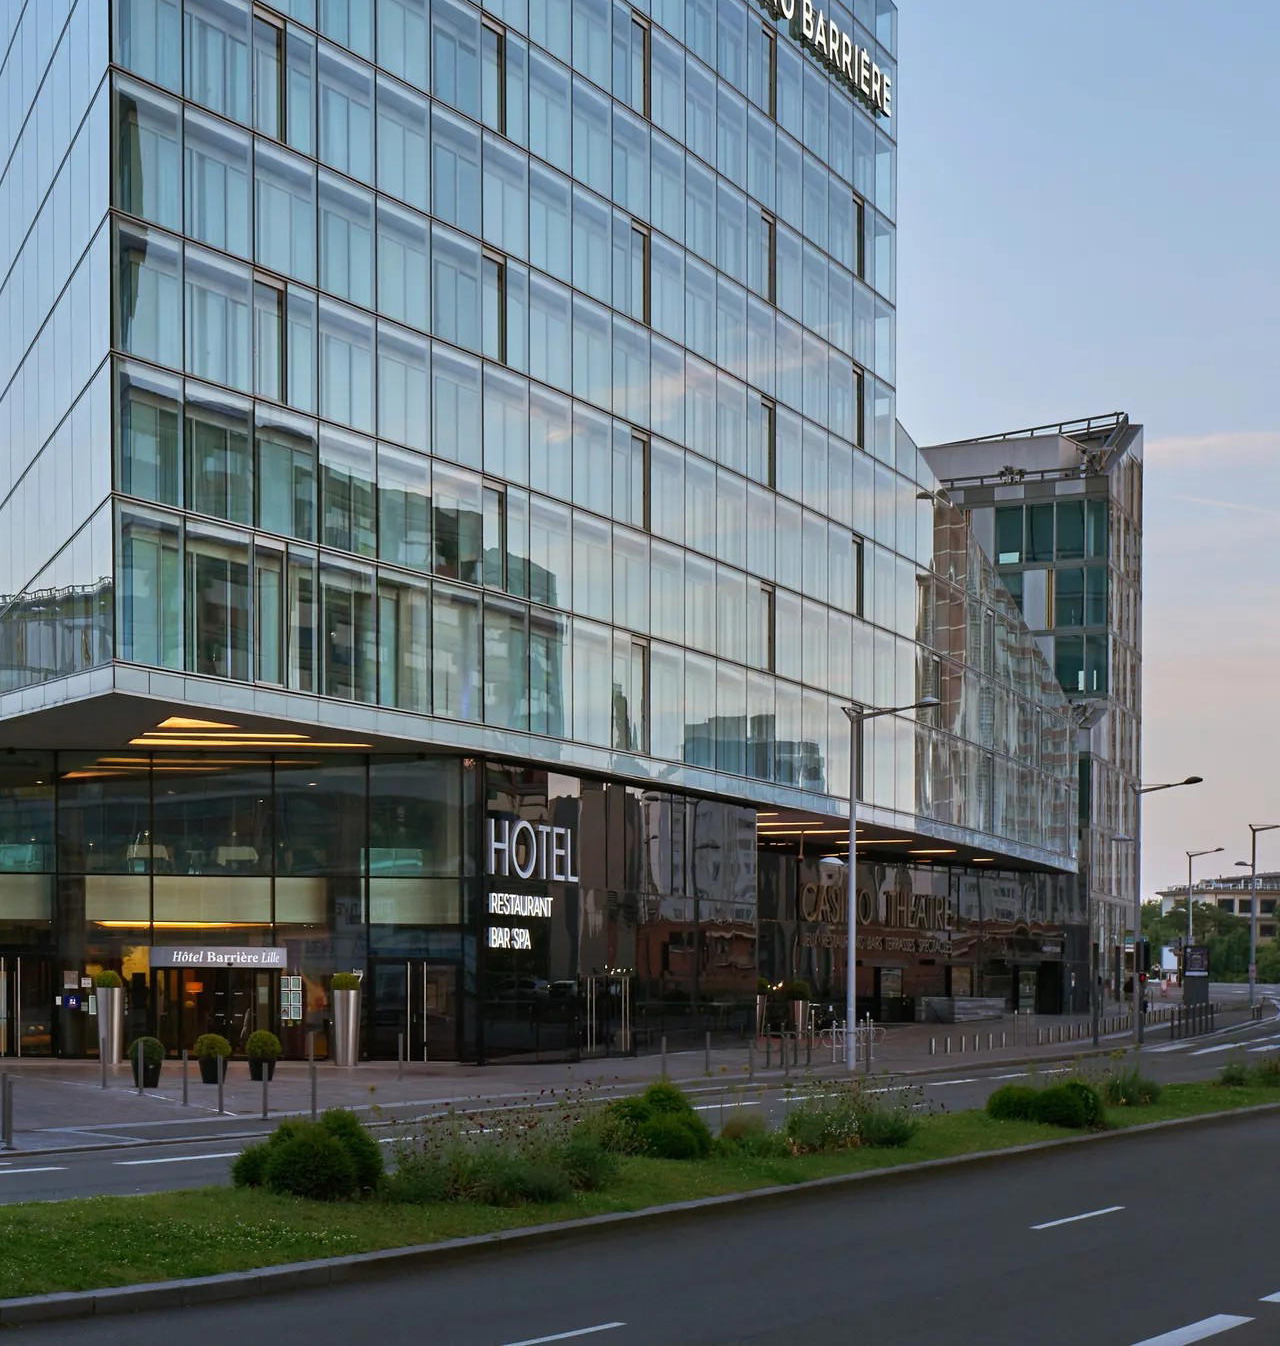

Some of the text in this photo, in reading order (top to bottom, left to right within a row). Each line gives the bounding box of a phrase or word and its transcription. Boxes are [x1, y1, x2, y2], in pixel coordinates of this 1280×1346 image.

[487, 818, 579, 883] HOTEL
[488, 892, 554, 918] RESTAURANT
[801, 883, 873, 925] CASIO
[488, 926, 532, 951] BAR SPA
[172, 950, 281, 964] Hôtel Barrière Lille
